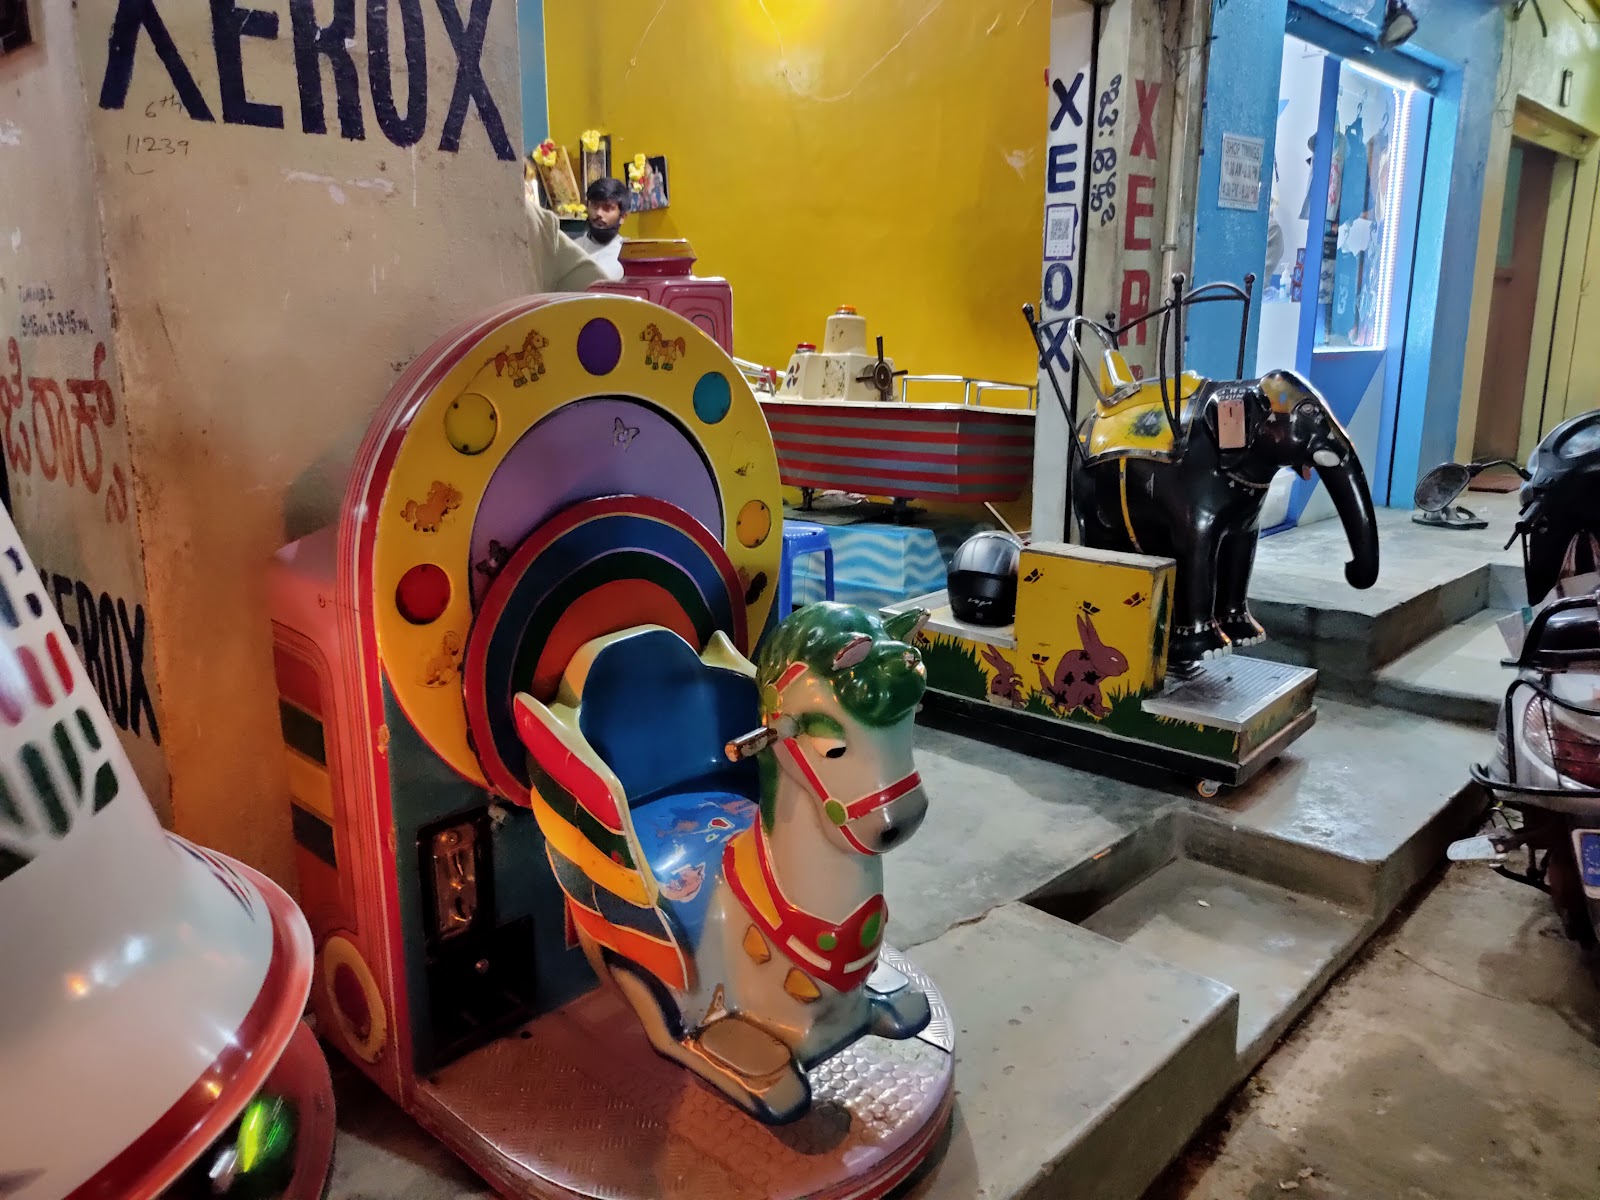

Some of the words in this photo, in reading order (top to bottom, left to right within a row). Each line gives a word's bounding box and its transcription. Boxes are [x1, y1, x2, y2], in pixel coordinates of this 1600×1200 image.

[126, 133, 189, 157] 11239
[144, 94, 183, 118] 6th
[1039, 72, 1085, 373] XEOX
[40, 568, 161, 747] EROX
